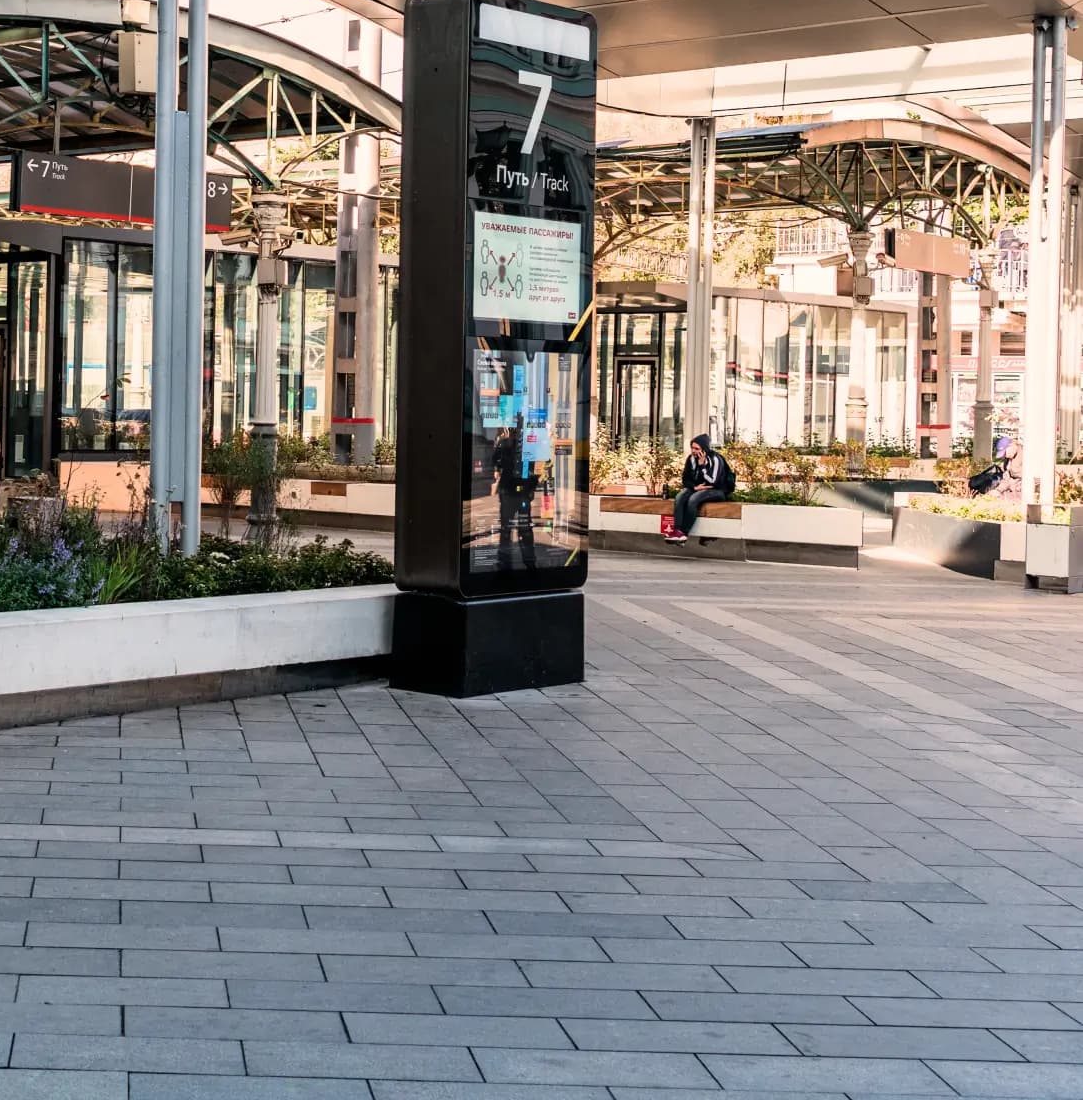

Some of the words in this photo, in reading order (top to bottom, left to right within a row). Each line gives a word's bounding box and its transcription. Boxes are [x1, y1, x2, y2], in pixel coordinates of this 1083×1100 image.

[518, 69, 552, 154] 7
[41, 160, 50, 178] 7
[52, 161, 69, 172] Путь
[496, 164, 529, 188] Путь
[532, 172, 537, 187] /
[540, 172, 569, 192] Track
[207, 181, 216, 198] 8
[481, 222, 528, 235] УВАЖАЕМЫЕ
[529, 227, 574, 240] ПАССАЖИРЫ!
